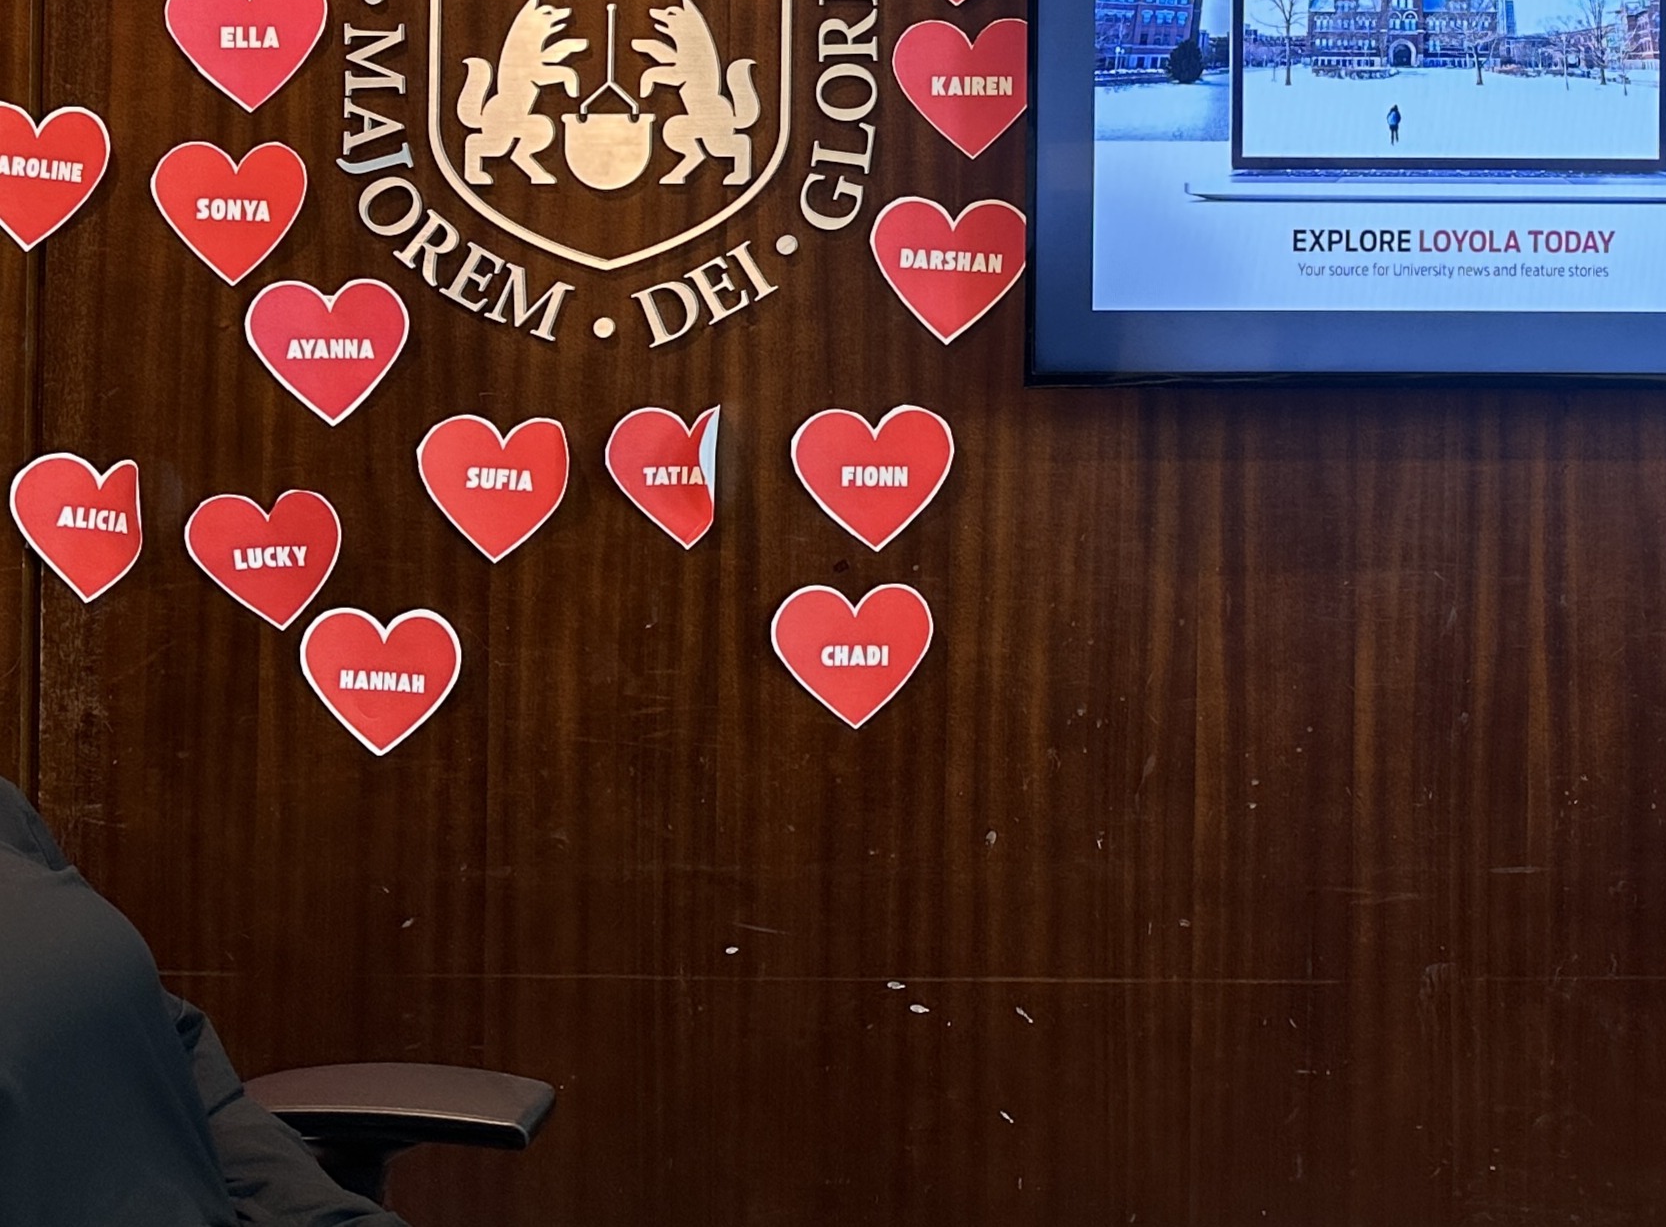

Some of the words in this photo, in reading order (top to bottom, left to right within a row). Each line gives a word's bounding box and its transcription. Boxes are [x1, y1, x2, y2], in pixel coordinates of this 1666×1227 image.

[220, 26, 279, 48] ELLA
[931, 76, 1013, 97] KAIREN
[0, 155, 83, 183] AROLINE
[335, 22, 576, 342] MAJOREM
[631, 248, 778, 347] DEI
[196, 199, 270, 222] SONYA
[1293, 229, 1412, 252] EXPLORE
[1419, 230, 1521, 253] LOYOLA
[1527, 231, 1616, 253] TODAY
[899, 246, 1002, 273] DARSHAN
[1298, 263, 1325, 276] Your
[1329, 265, 1369, 276] source
[1373, 263, 1390, 276] for
[1393, 263, 1454, 279] University
[1458, 266, 1490, 277] news
[1493, 263, 1516, 277] and
[1521, 263, 1565, 277] feature
[1568, 264, 1609, 277] stories
[287, 339, 374, 360] AYANNA
[465, 467, 533, 492] SUFIA
[643, 466, 708, 486] TATIA
[842, 466, 909, 487] FIONN
[57, 505, 128, 534] ALICIA
[233, 546, 307, 570] LUCKY
[820, 646, 888, 667] CHADI
[339, 669, 425, 694] HANNAH
